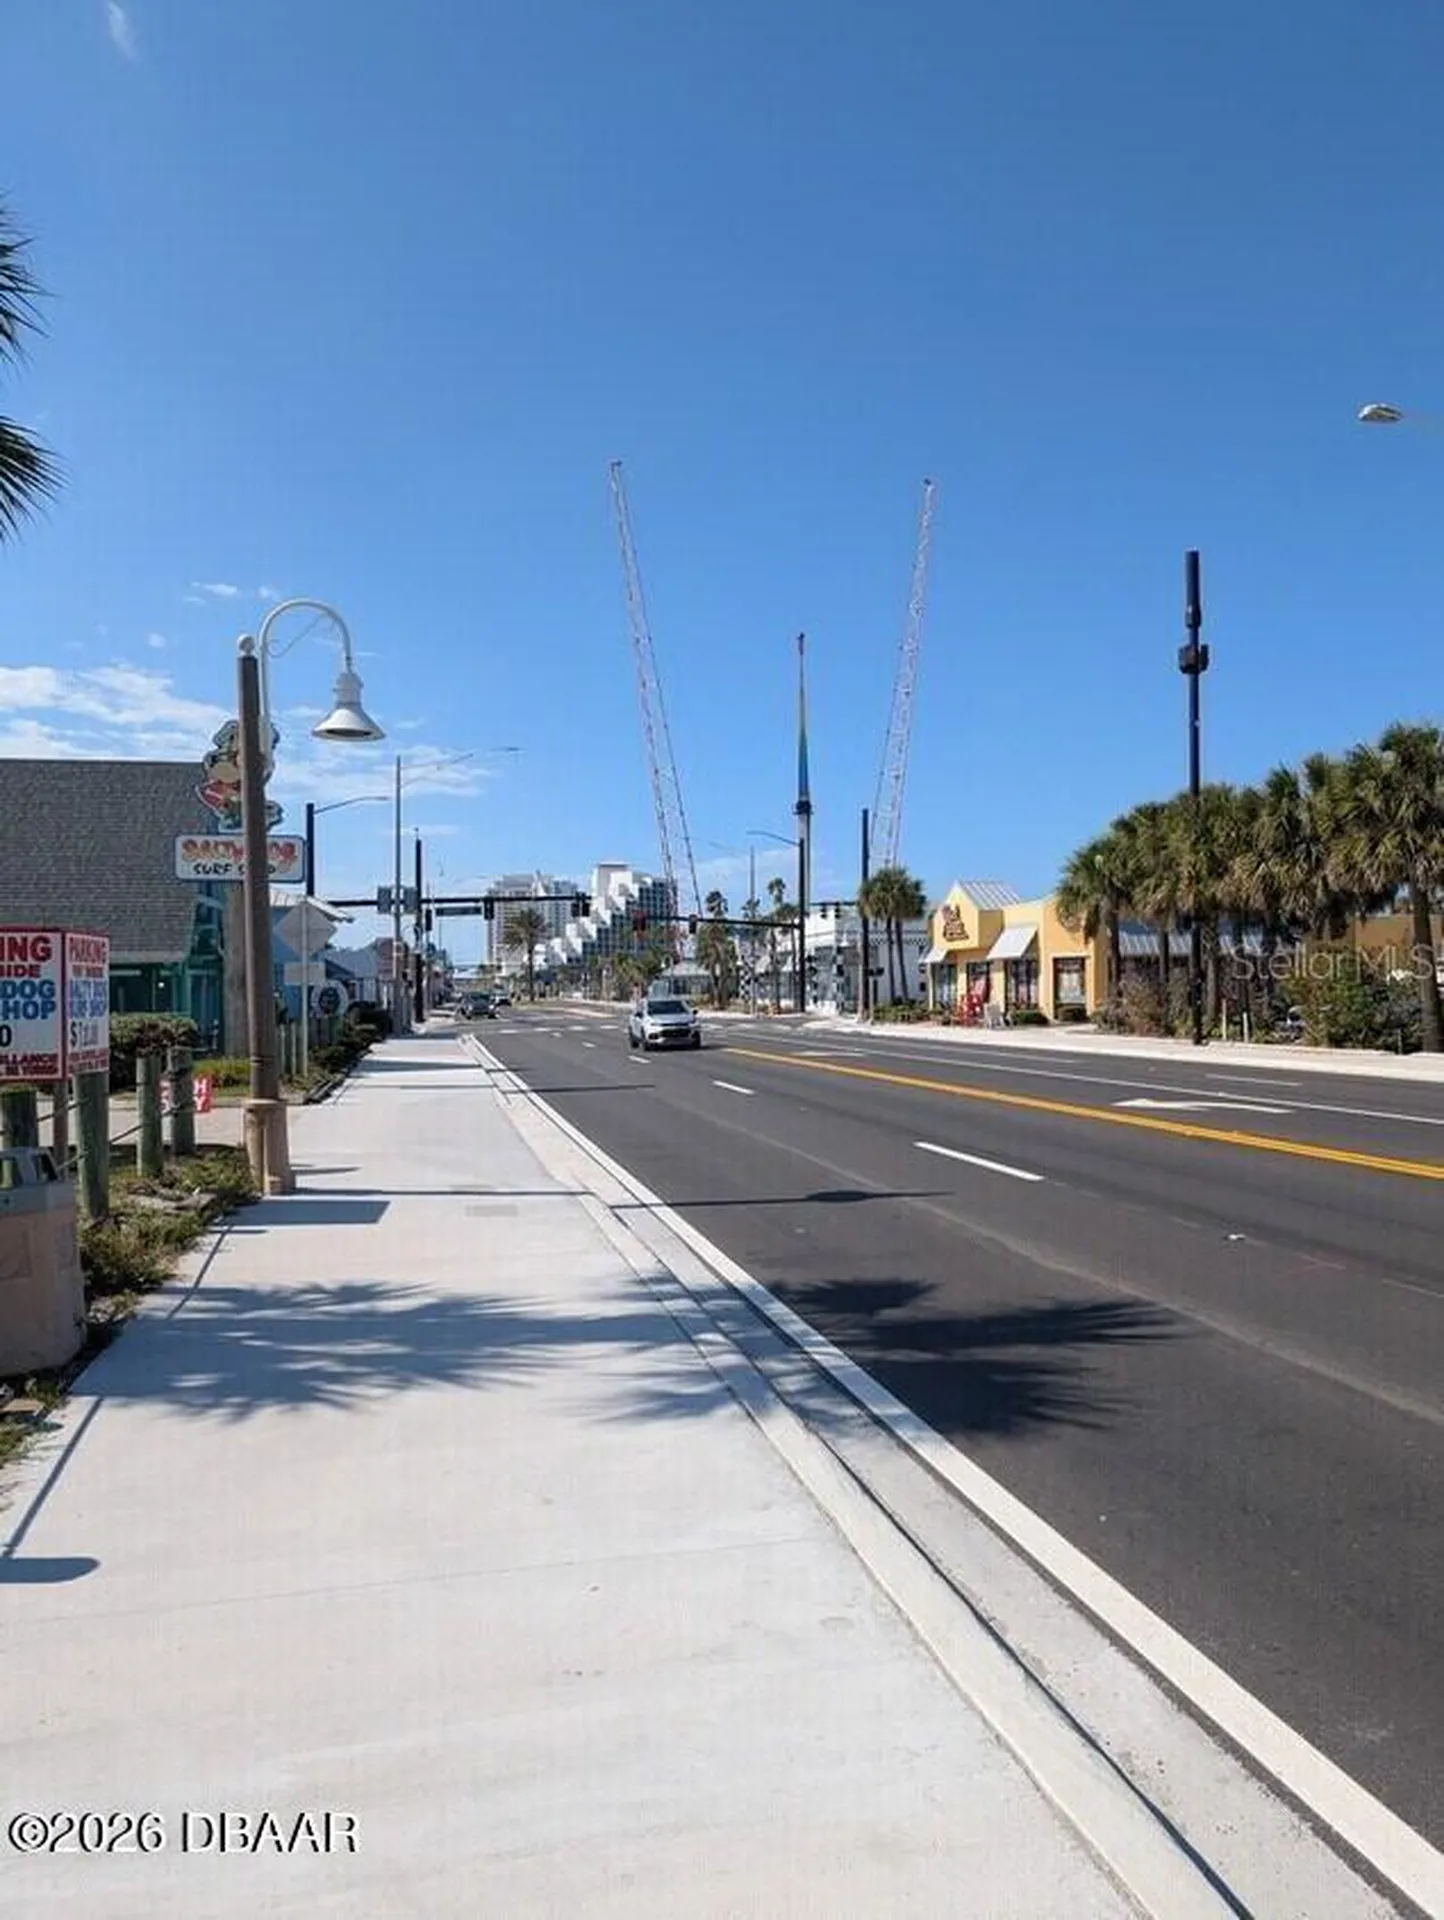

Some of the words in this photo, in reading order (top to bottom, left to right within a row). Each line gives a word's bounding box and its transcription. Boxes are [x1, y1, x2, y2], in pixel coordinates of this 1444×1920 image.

[193, 863, 233, 876] SURF
[0, 980, 56, 999] DOG
[3, 1000, 56, 1020] HOP
